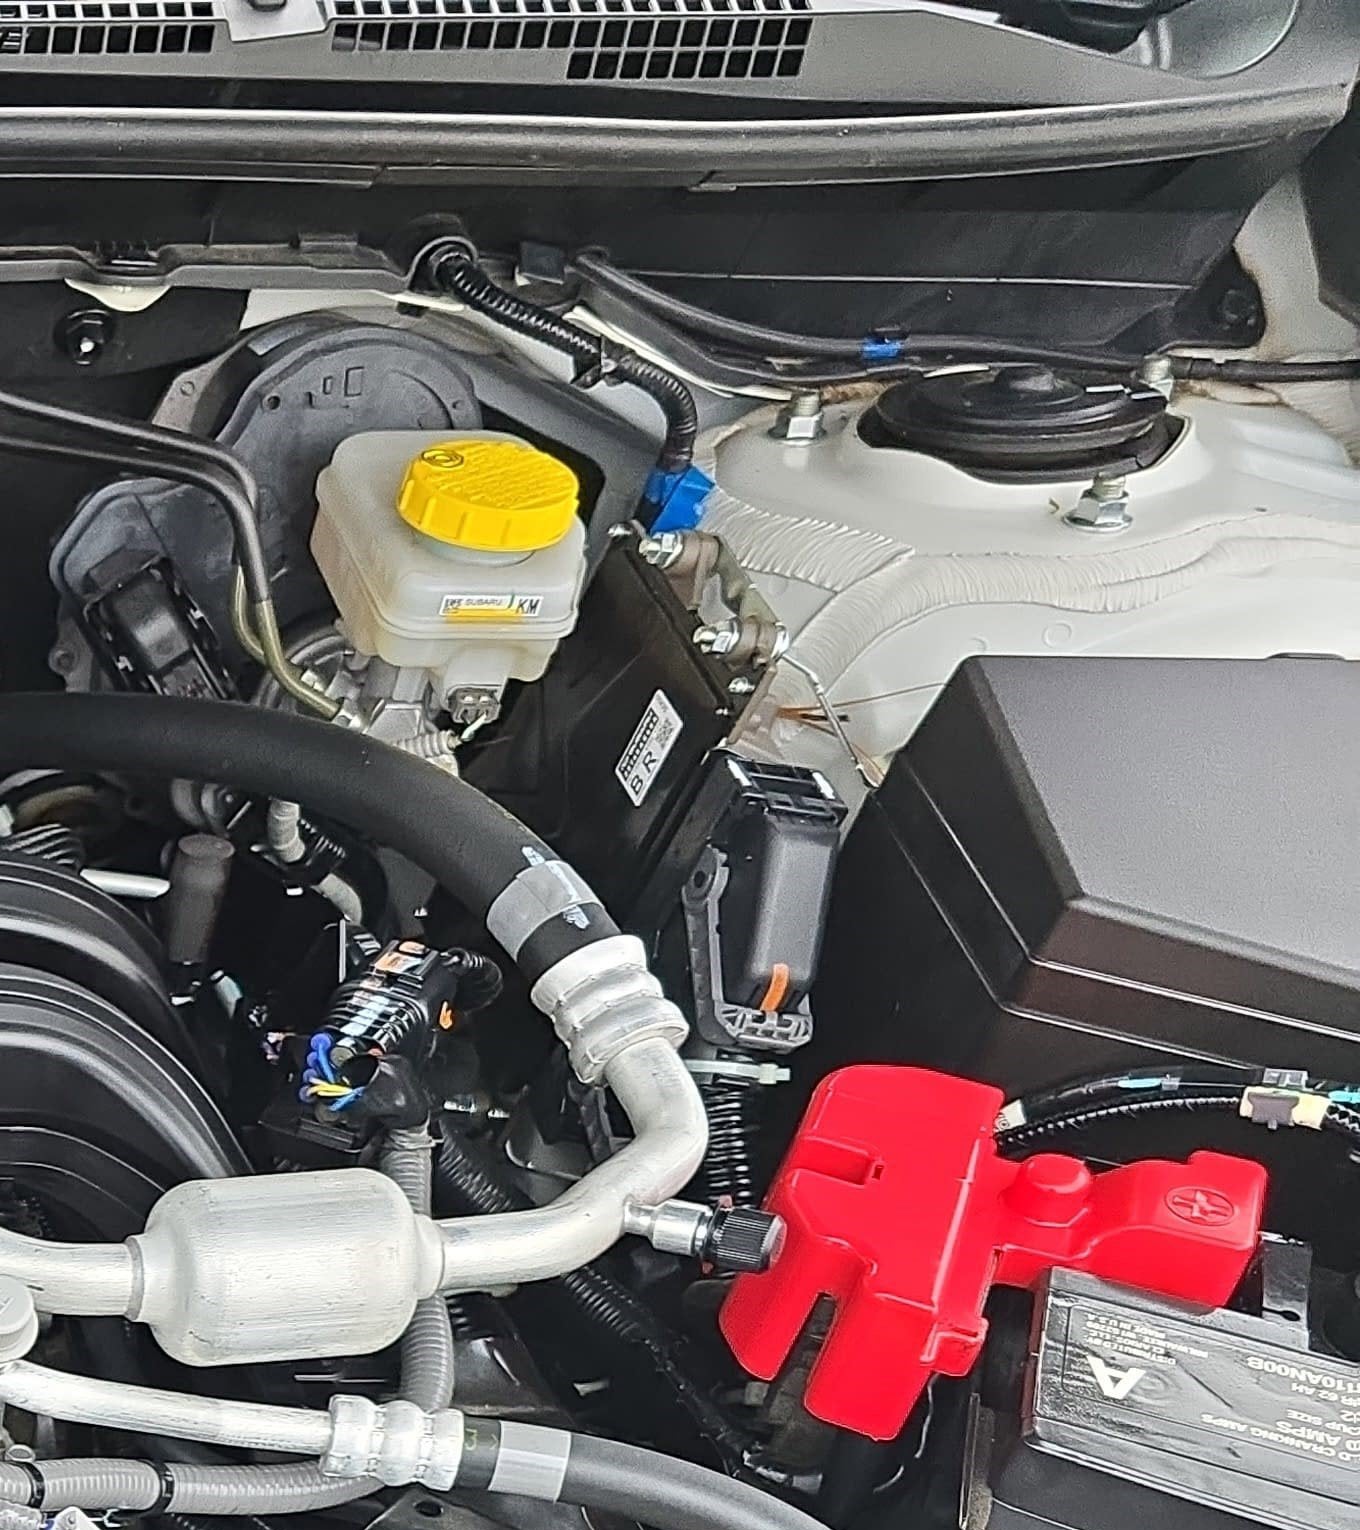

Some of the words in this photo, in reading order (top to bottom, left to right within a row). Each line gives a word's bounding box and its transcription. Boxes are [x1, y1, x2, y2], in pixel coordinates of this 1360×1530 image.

[1086, 1354, 1147, 1400] A
[1246, 1355, 1360, 1395] 110AN00B
[1291, 1382, 1317, 1395] AH
[1200, 1413, 1249, 1432] AMPS
[1285, 1408, 1323, 1426] SIZE
[1275, 1420, 1342, 1446] AMPS
[1324, 1421, 1360, 1436] OUP
[1249, 1426, 1337, 1457] CRANKING
